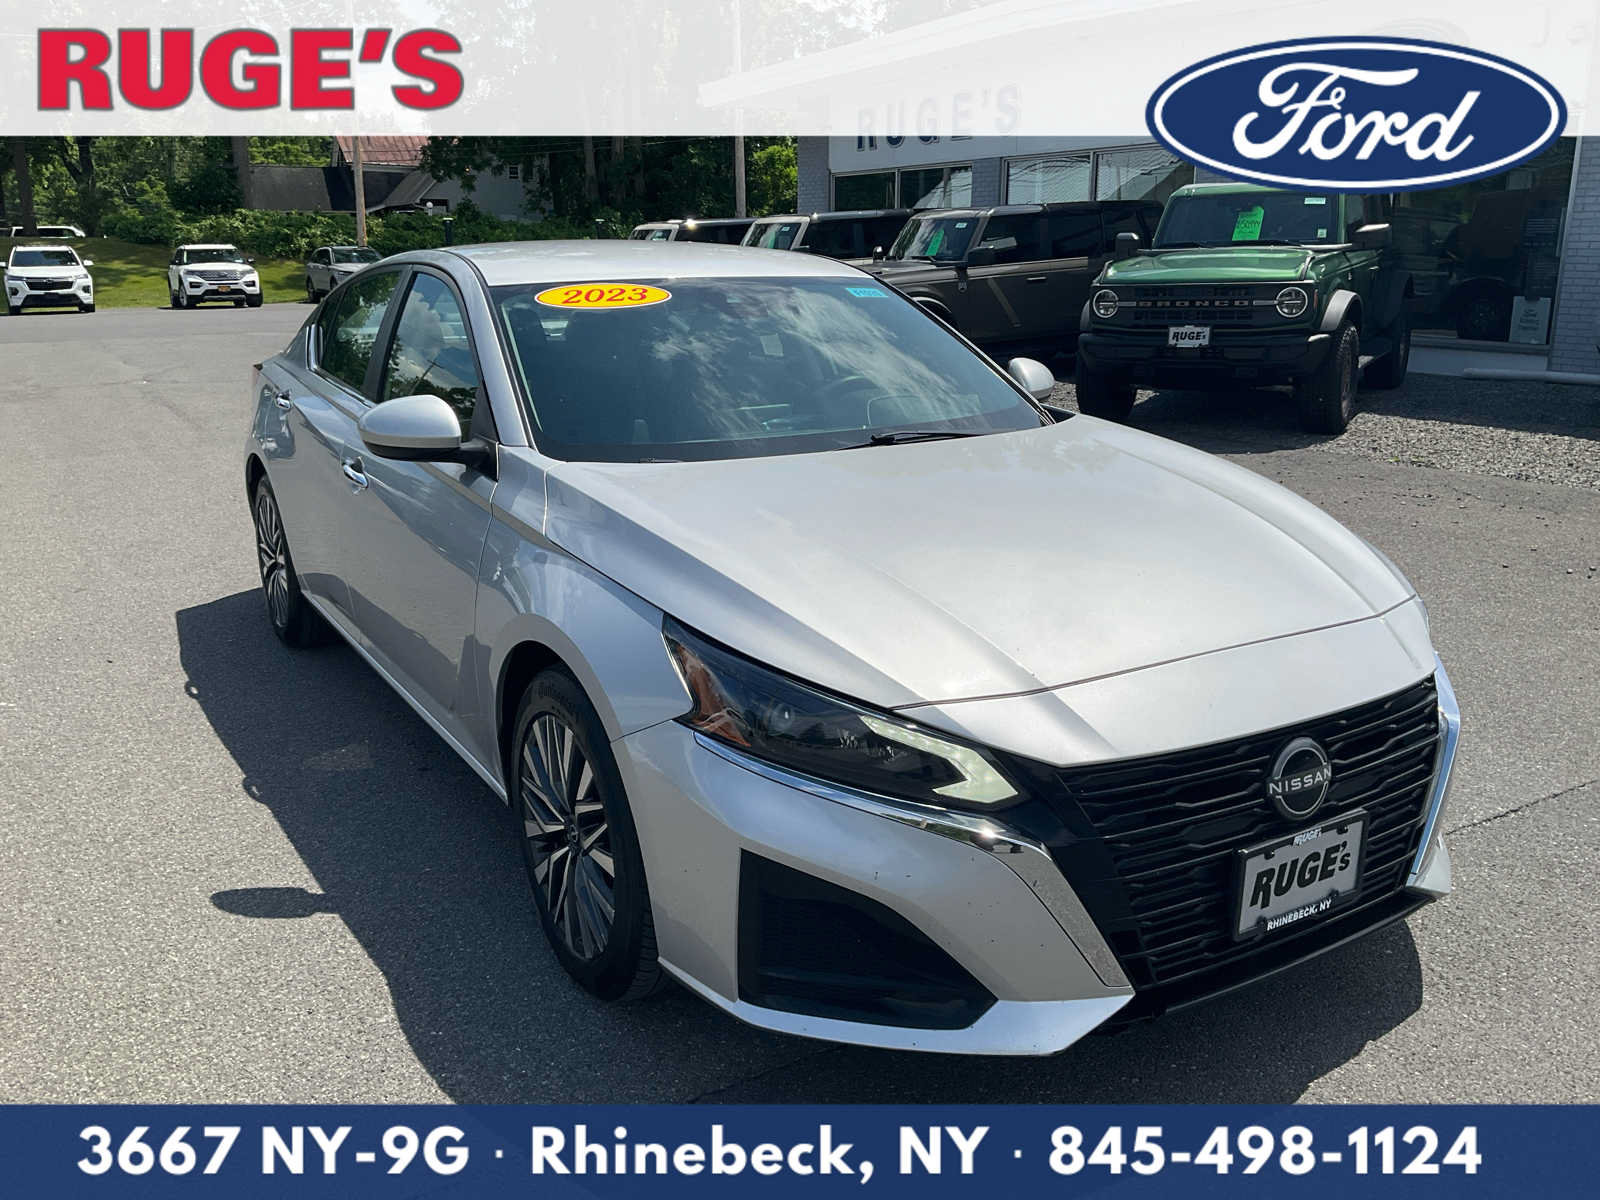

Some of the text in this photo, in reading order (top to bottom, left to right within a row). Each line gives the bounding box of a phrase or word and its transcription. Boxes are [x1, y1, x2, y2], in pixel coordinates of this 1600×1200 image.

[562, 288, 648, 304] 2023
[1138, 300, 1250, 308] BRONCO
[1269, 766, 1332, 794] NISSAN
[1266, 898, 1332, 931] RHINEBECK, NY
